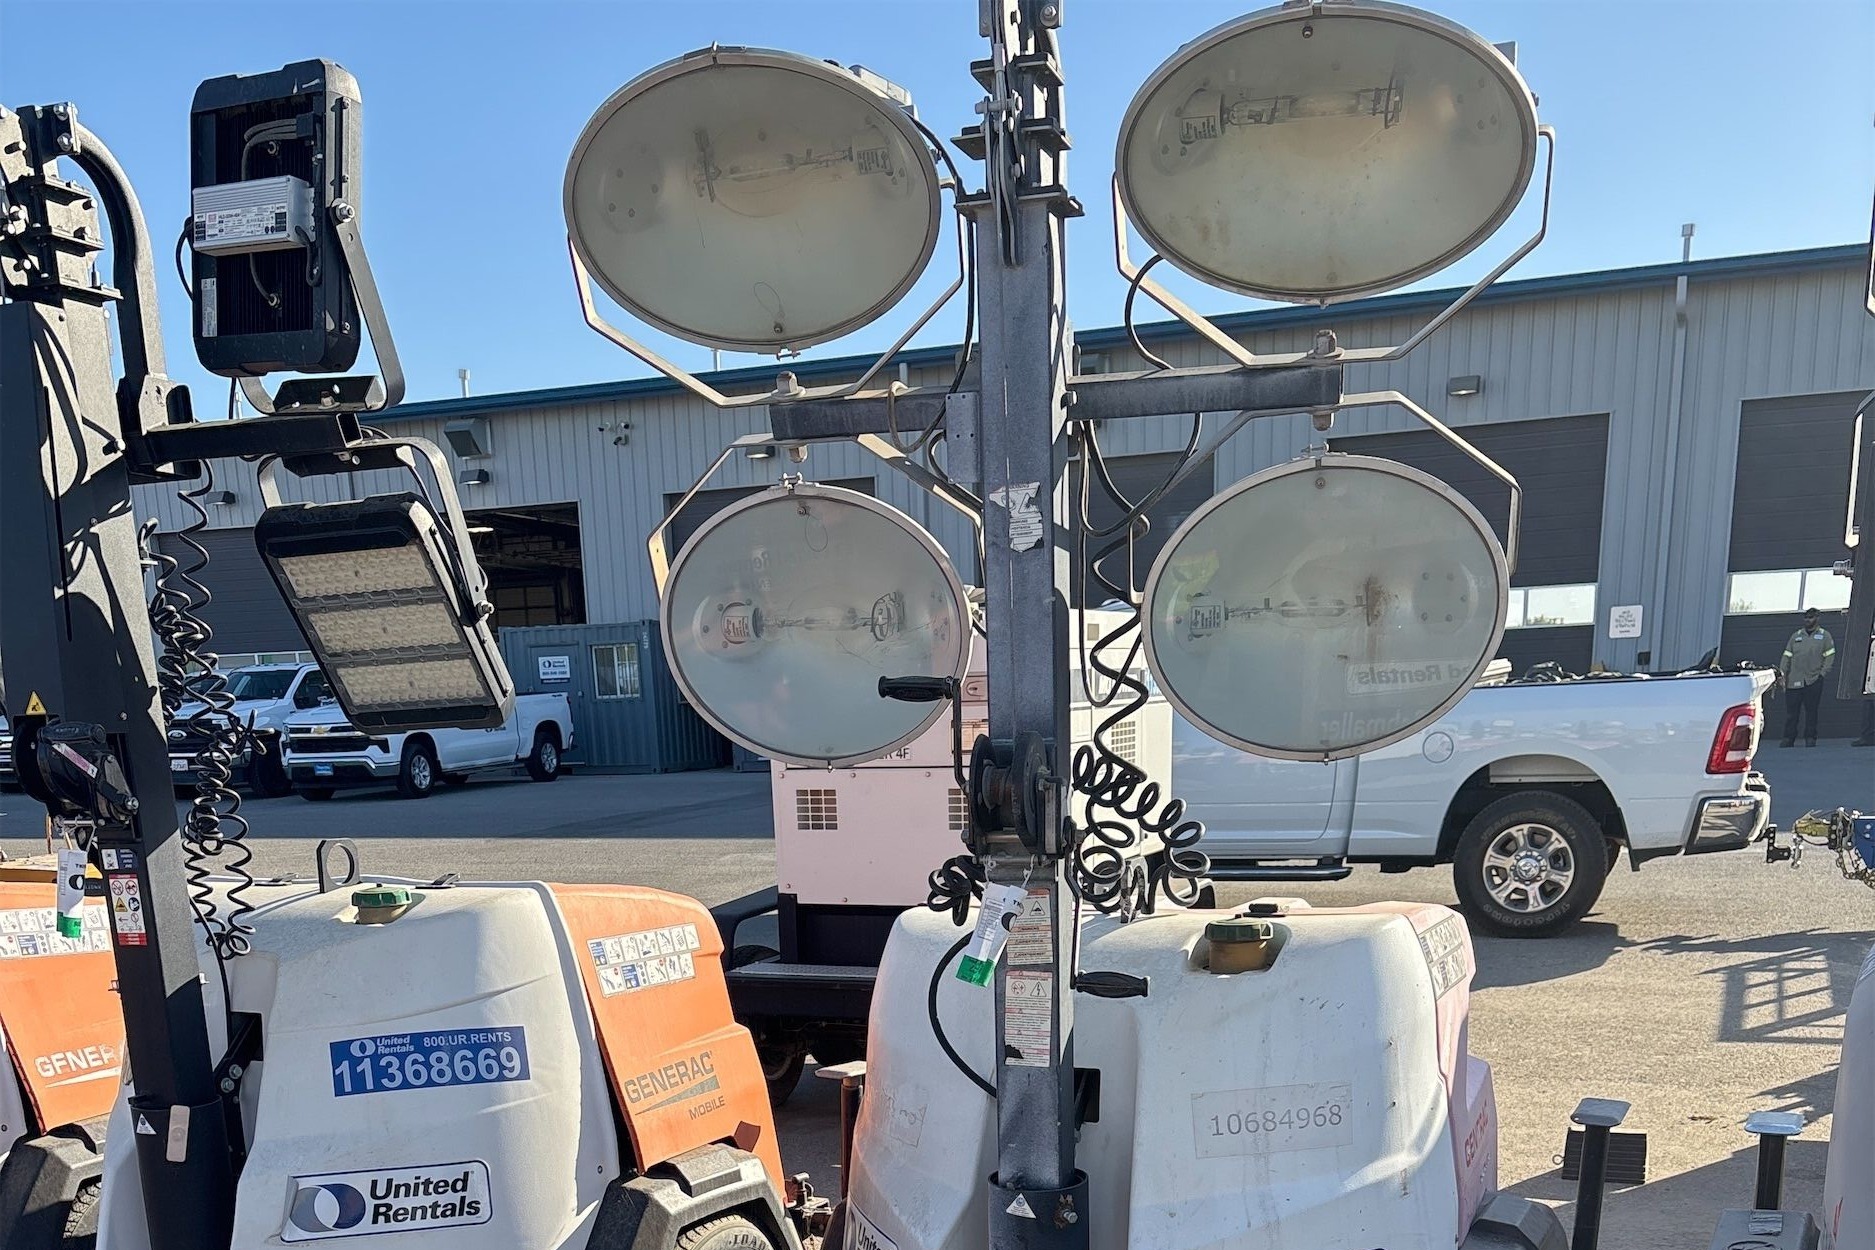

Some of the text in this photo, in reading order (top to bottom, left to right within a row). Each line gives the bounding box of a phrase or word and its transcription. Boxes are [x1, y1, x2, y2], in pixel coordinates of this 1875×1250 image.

[376, 1035, 411, 1046] United
[377, 1043, 415, 1055] Rentals
[423, 1031, 512, 1048] 800.UR.RENTS
[334, 1046, 522, 1093] 11368669
[623, 1050, 715, 1105] GENERAC
[688, 1095, 727, 1121] MOBILE
[1210, 1104, 1343, 1137] 10684968
[369, 1171, 470, 1201] United
[371, 1195, 481, 1225] Rentals
